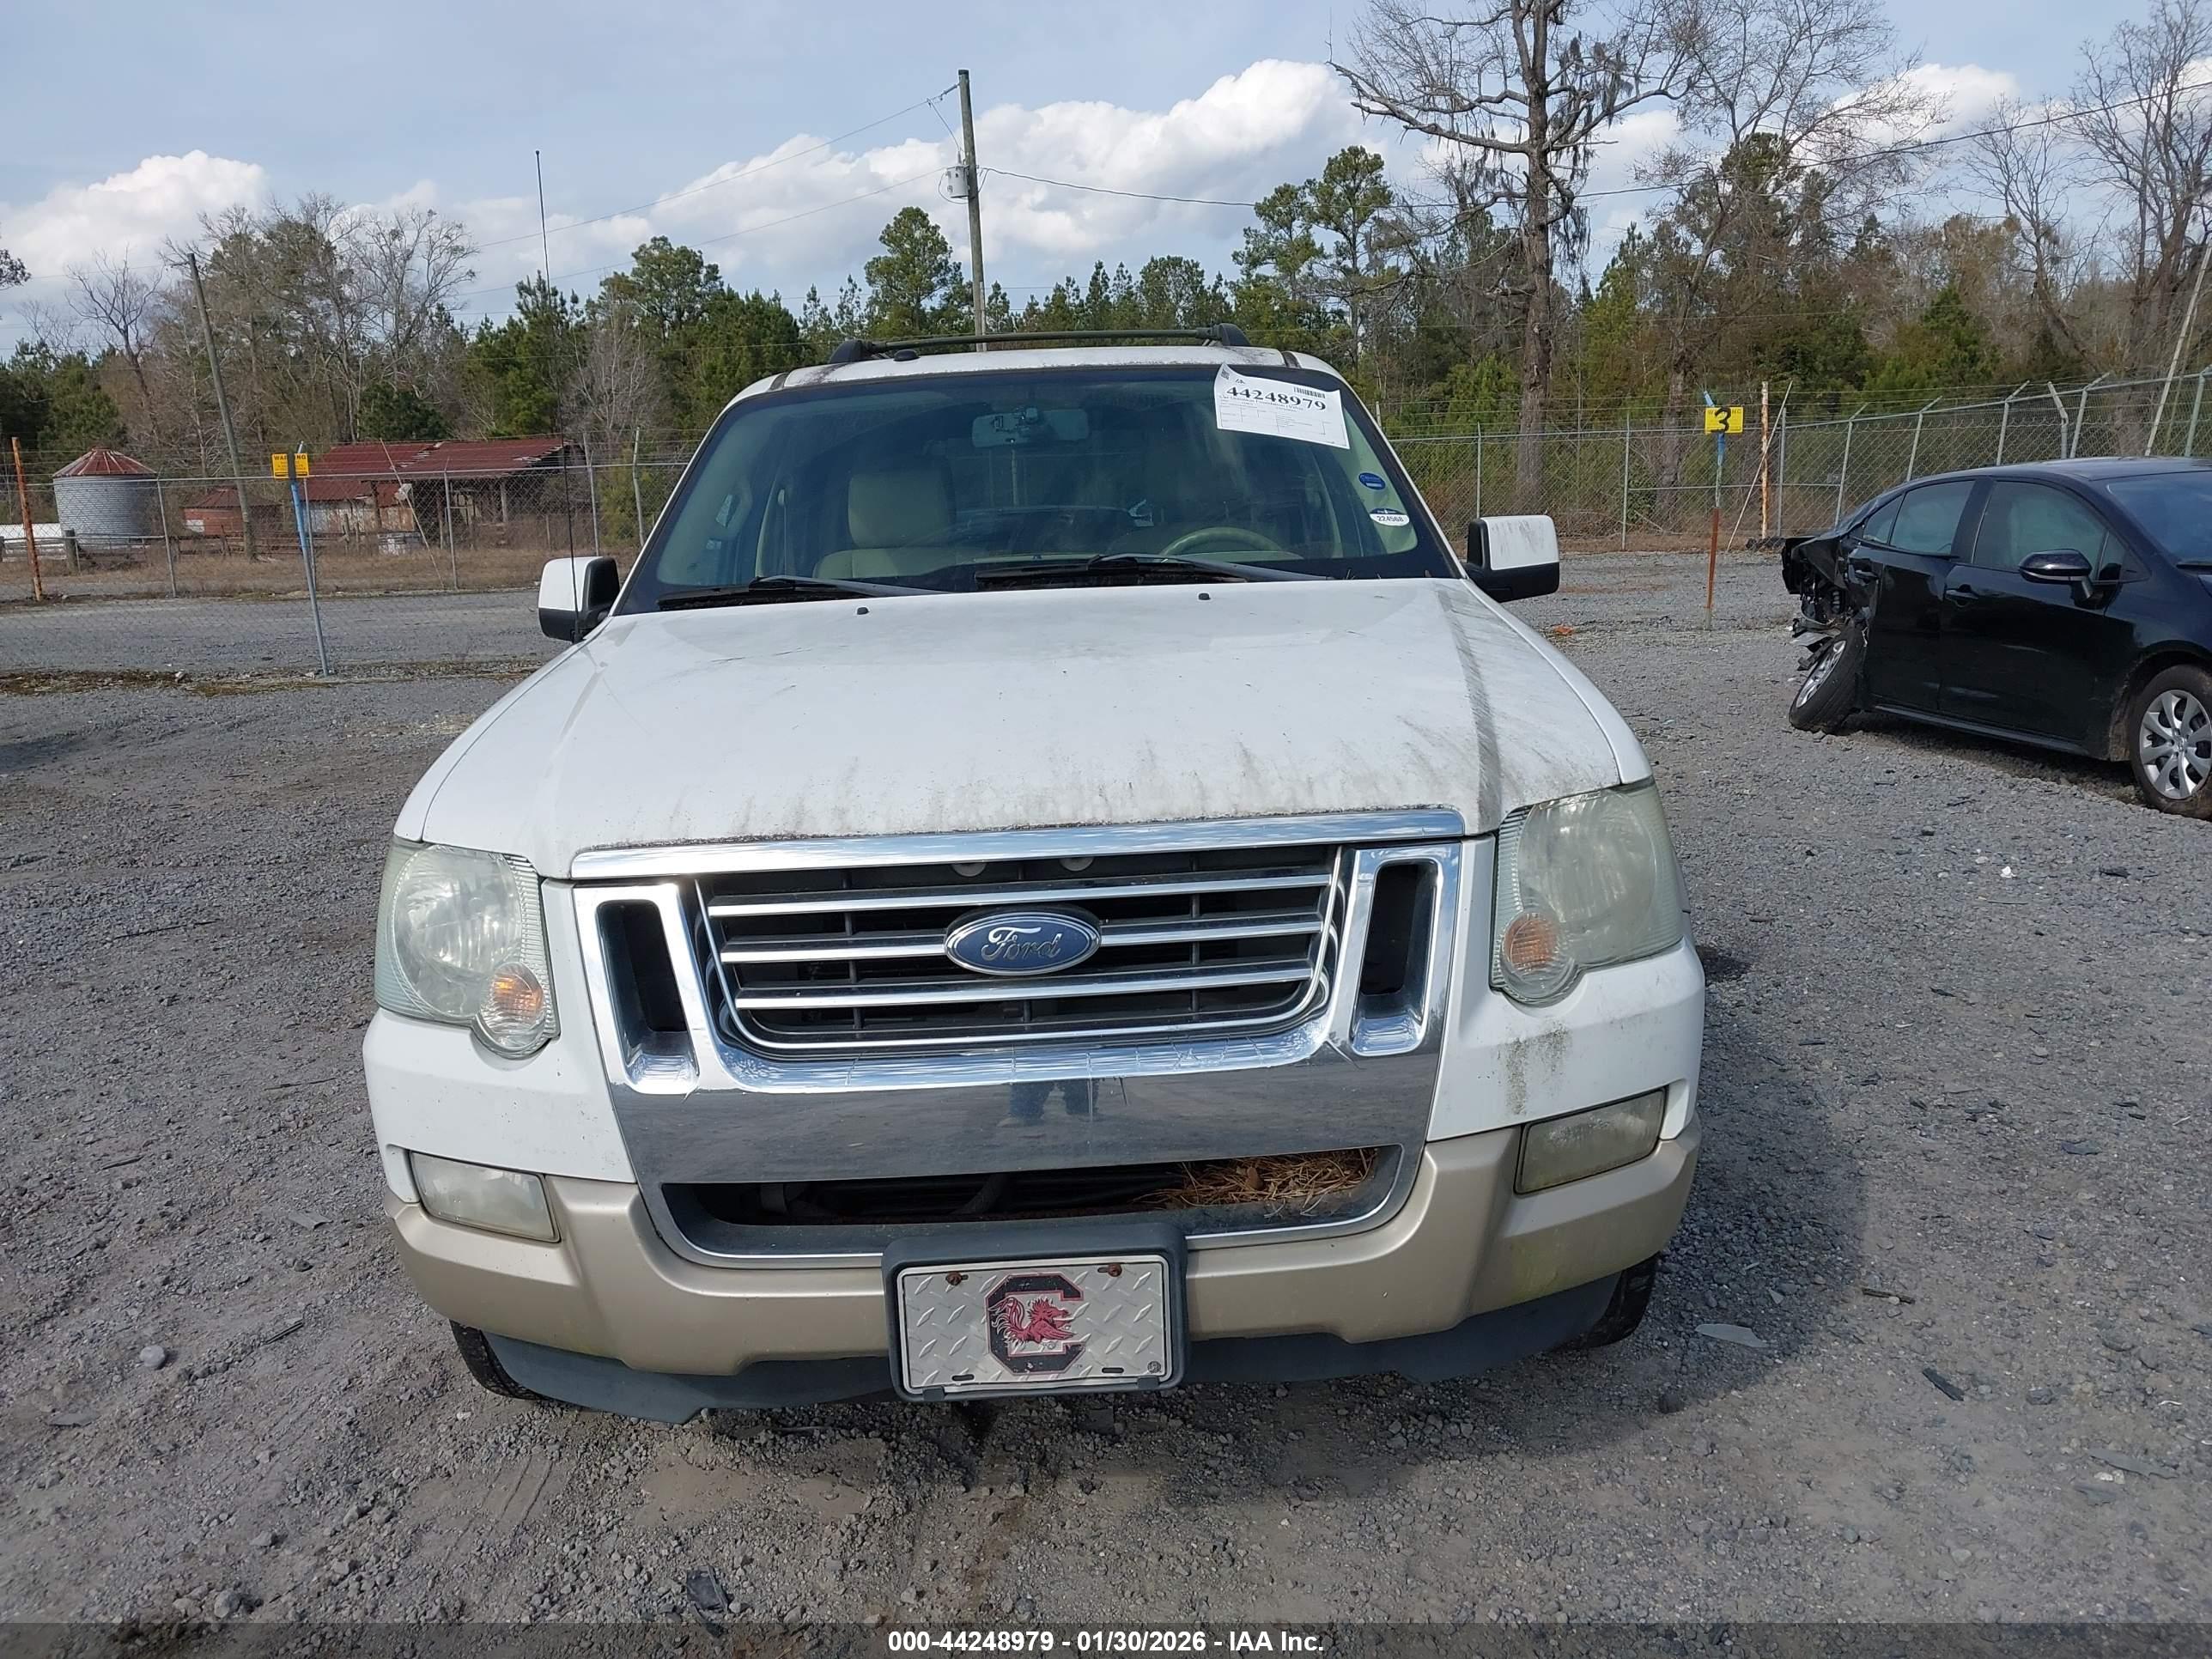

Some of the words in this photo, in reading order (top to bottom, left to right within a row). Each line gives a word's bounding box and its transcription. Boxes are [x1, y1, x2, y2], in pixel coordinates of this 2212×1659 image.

[1226, 386, 1327, 411] 44248979
[1711, 406, 1732, 433] 3
[981, 927, 1063, 962] Ford
